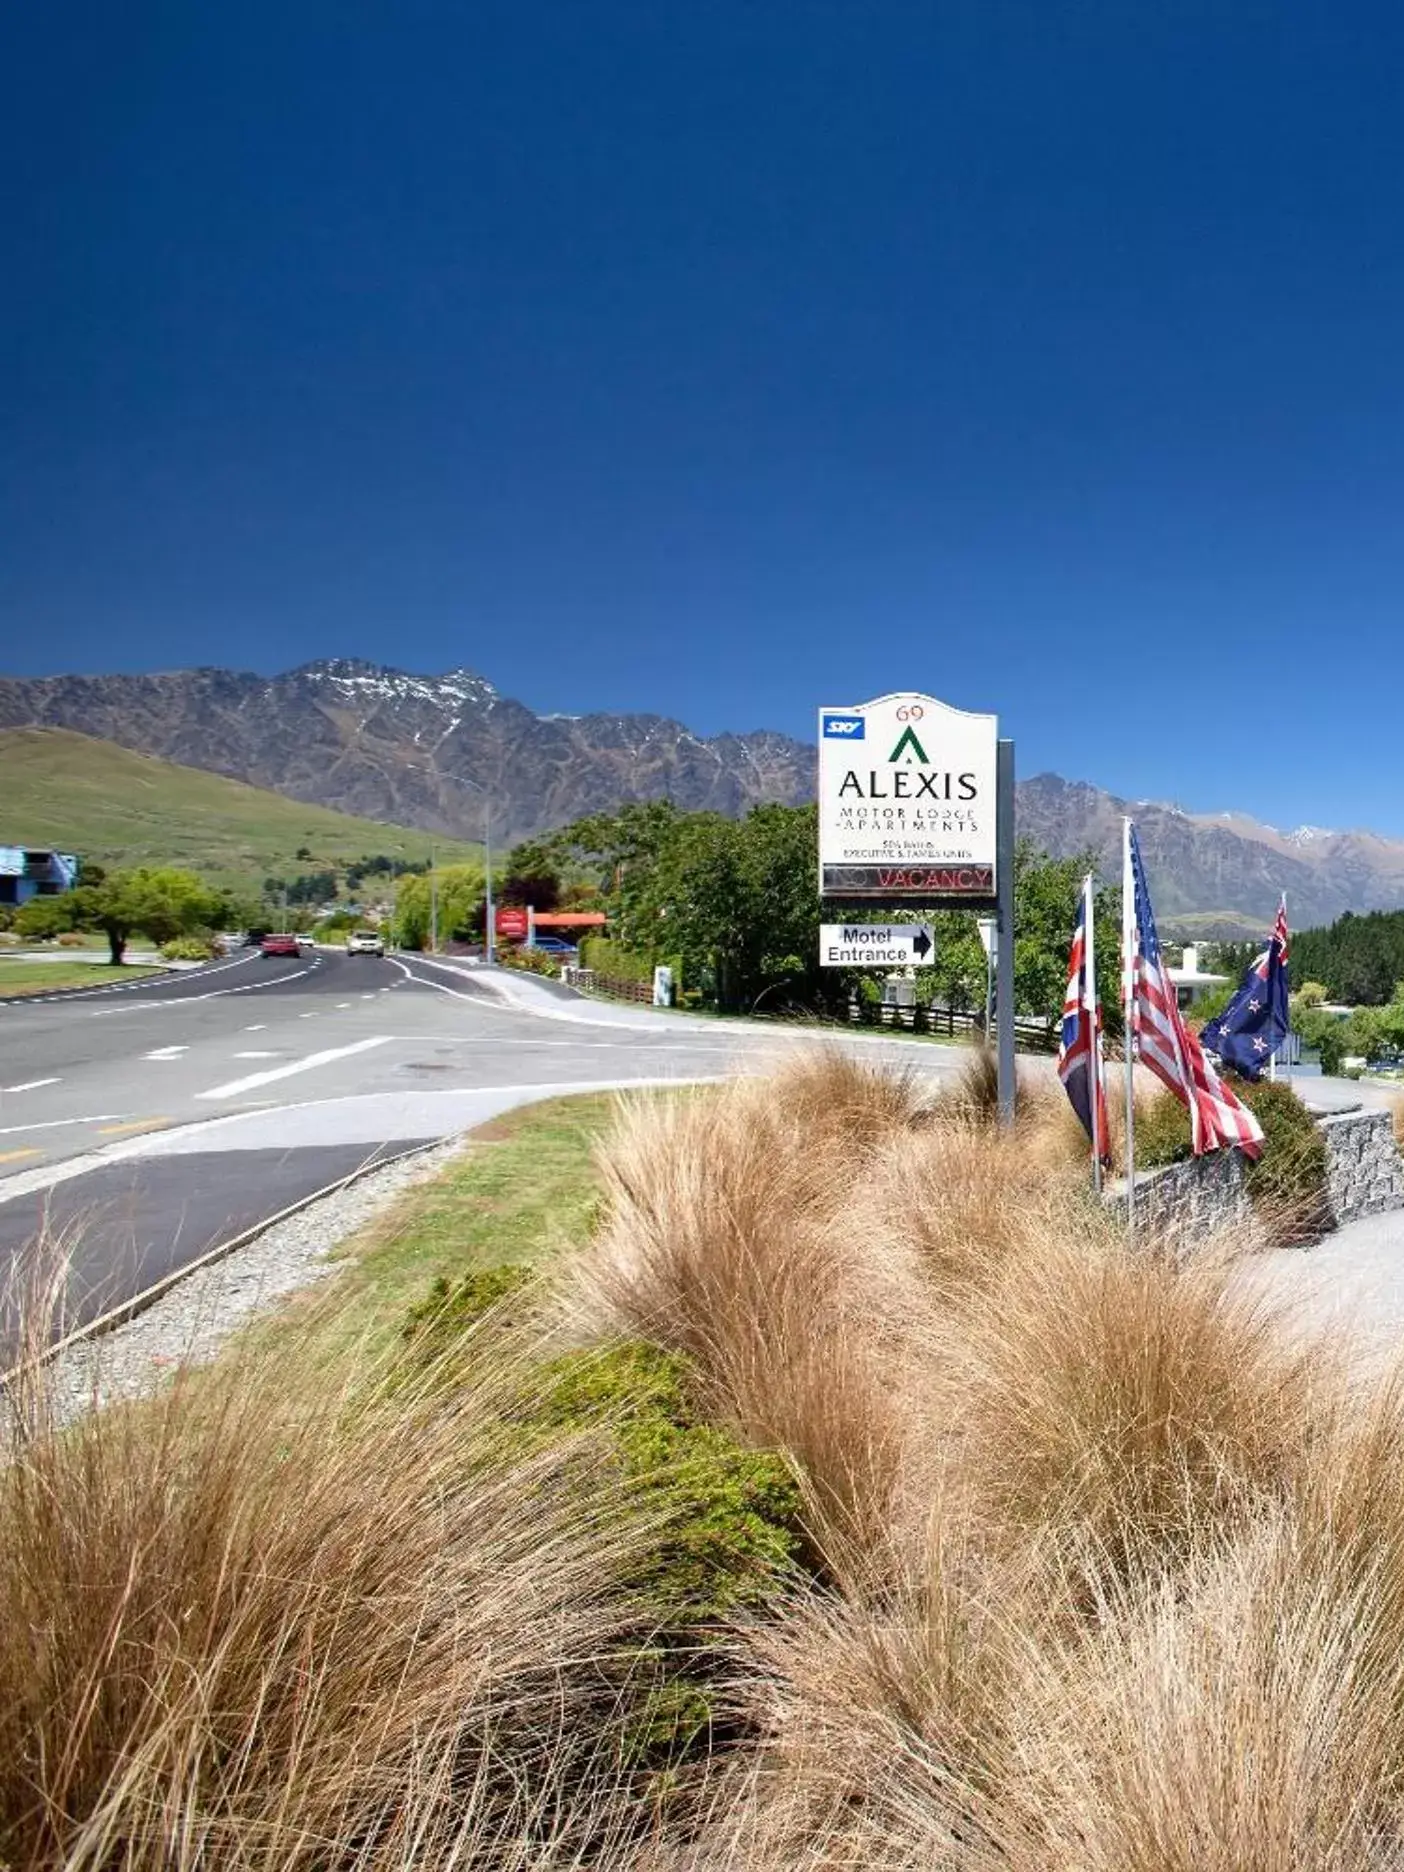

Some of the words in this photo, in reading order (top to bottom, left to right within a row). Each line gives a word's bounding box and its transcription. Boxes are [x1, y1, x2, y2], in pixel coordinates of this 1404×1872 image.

[895, 704, 925, 722] 69
[826, 720, 862, 734] SKY
[838, 770, 979, 801] ALEXIS
[839, 807, 906, 819] MOTOR
[916, 808, 975, 820] LODGE
[876, 868, 990, 888] VACANCY
[842, 929, 892, 944] Motel
[828, 946, 908, 962] Entrance
